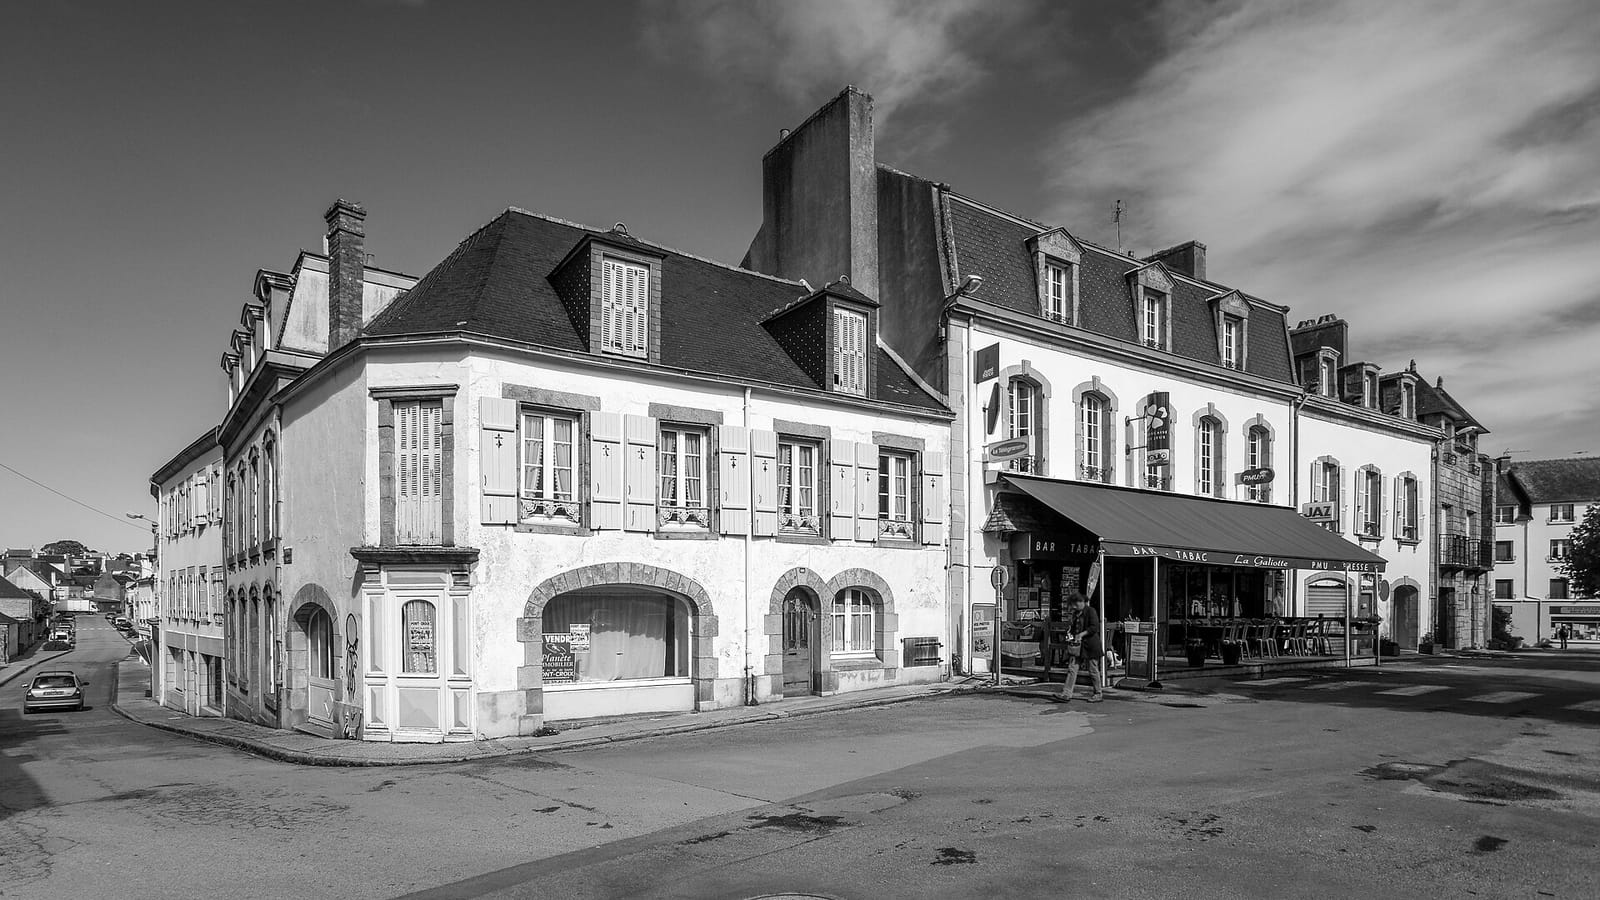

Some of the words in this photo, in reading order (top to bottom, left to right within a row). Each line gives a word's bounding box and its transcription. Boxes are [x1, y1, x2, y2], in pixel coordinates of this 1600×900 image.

[1303, 505, 1332, 518] JAZ
[1035, 541, 1055, 552] BAR
[1175, 550, 1208, 562] TABAC
[1234, 554, 1249, 564] La
[1253, 555, 1289, 567] Galiotte
[1311, 561, 1329, 570] PMU
[545, 635, 571, 644] VENDR
[542, 670, 575, 678] ONT-CROIX
